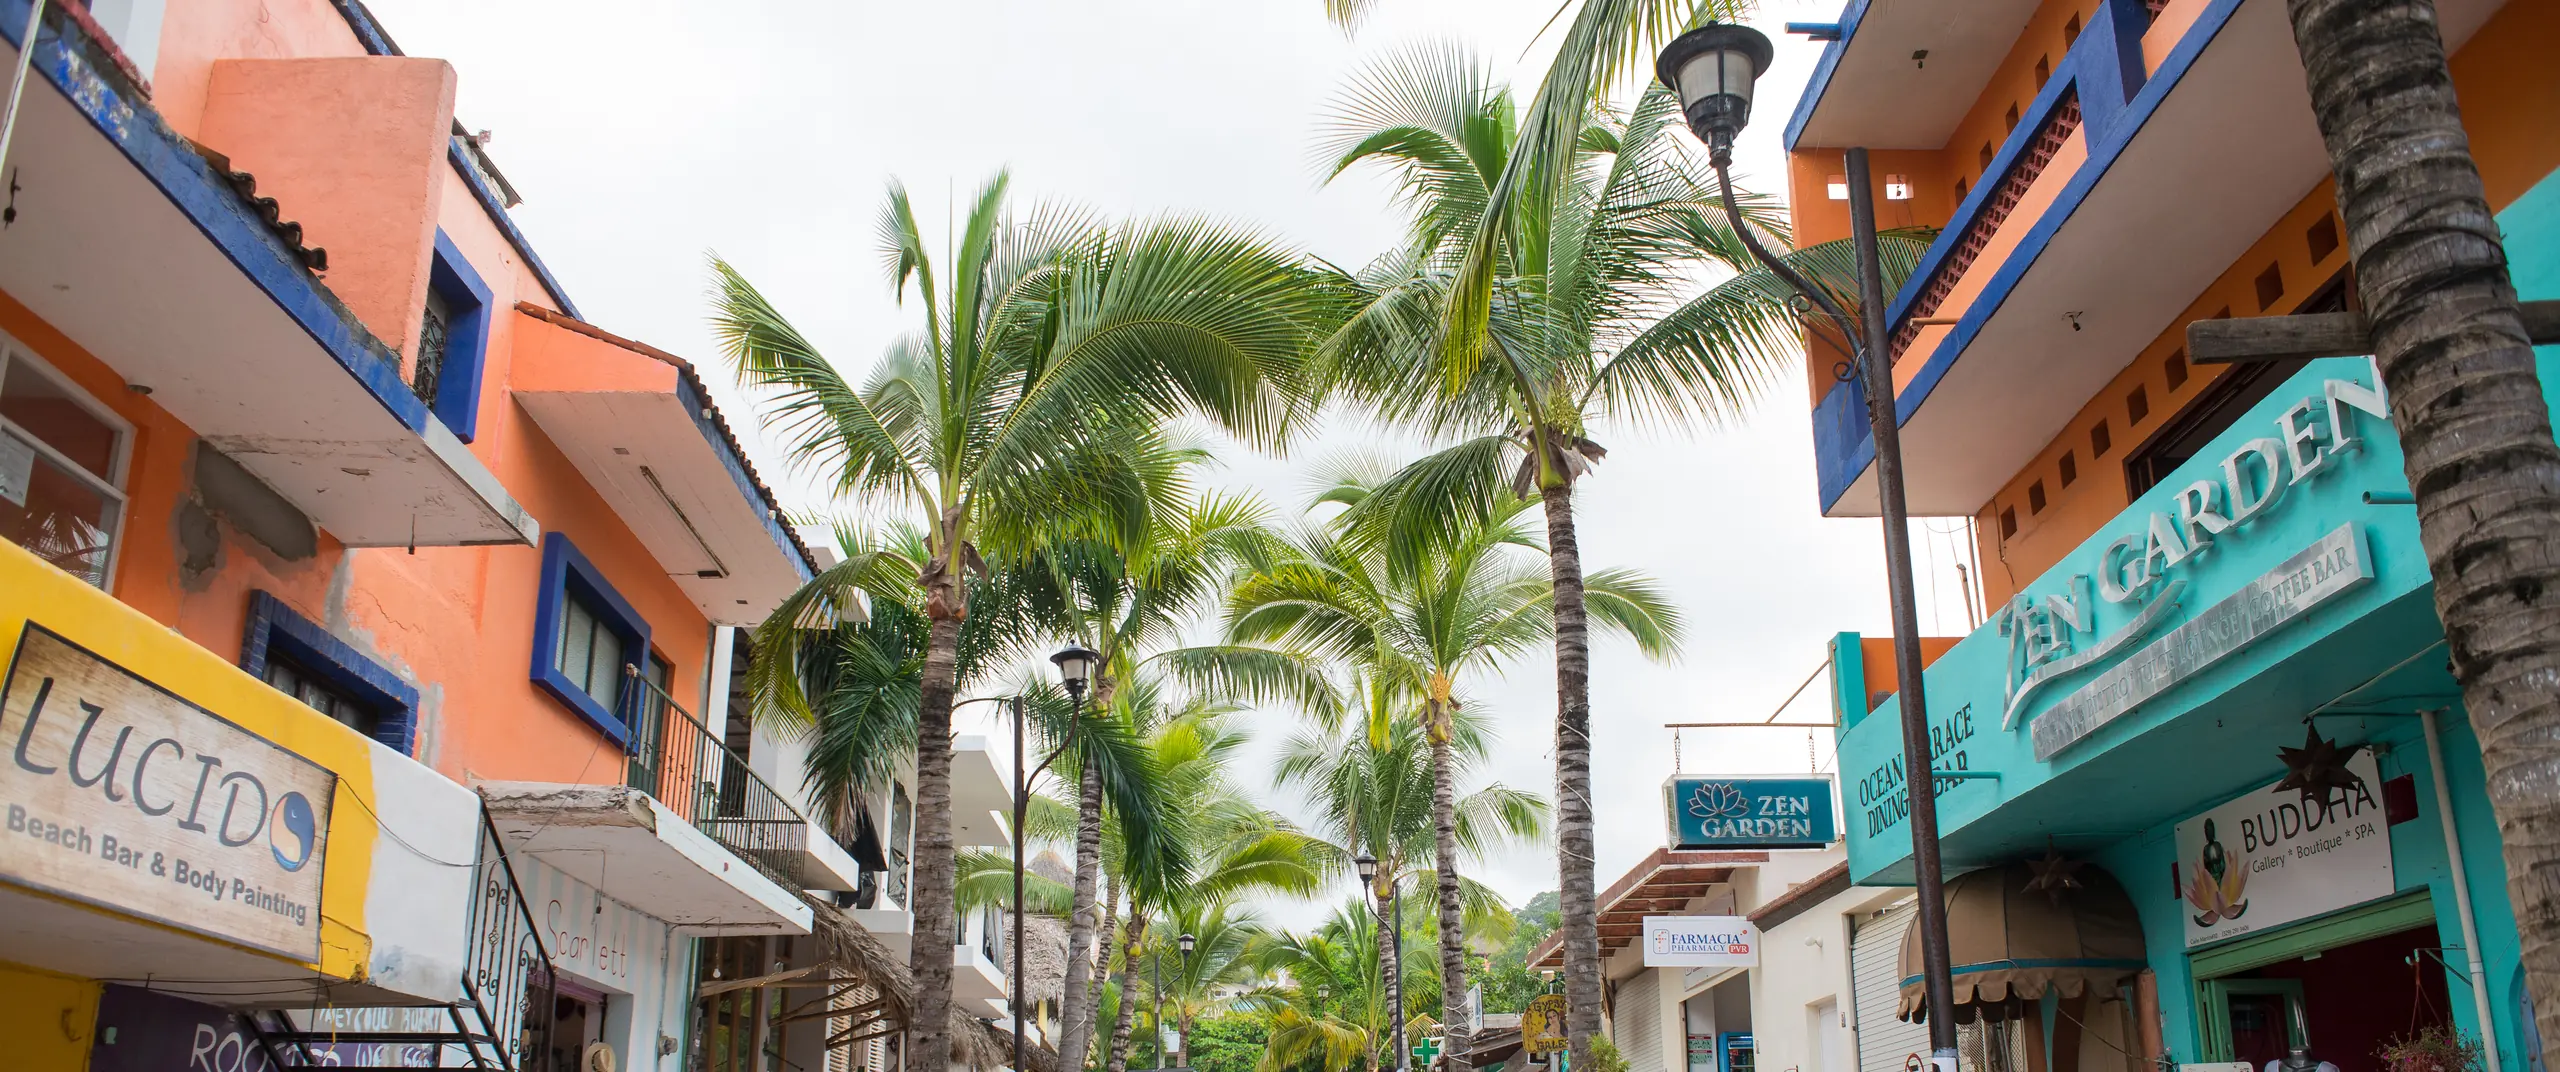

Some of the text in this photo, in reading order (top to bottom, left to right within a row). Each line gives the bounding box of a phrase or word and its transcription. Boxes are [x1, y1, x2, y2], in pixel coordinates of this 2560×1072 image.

[2099, 354, 2390, 603] GARDEN
[2250, 569, 2311, 622] COFFEE
[2312, 547, 2353, 585] BAR
[1859, 701, 1975, 807] OCEAN RACE
[1701, 817, 1812, 838] GARDEN
[1757, 795, 1810, 816] ZEN
[1867, 788, 1910, 839] DINING
[2240, 776, 2378, 853] BUDDHA
[7, 803, 307, 926] Beach Bar & Body Painting
[2252, 822, 2376, 873] Gallery Boutique SPA
[545, 899, 626, 978] Scarlett
[1671, 933, 1741, 944] FARMACIA
[1671, 944, 1748, 953] PHARMACY PVR
